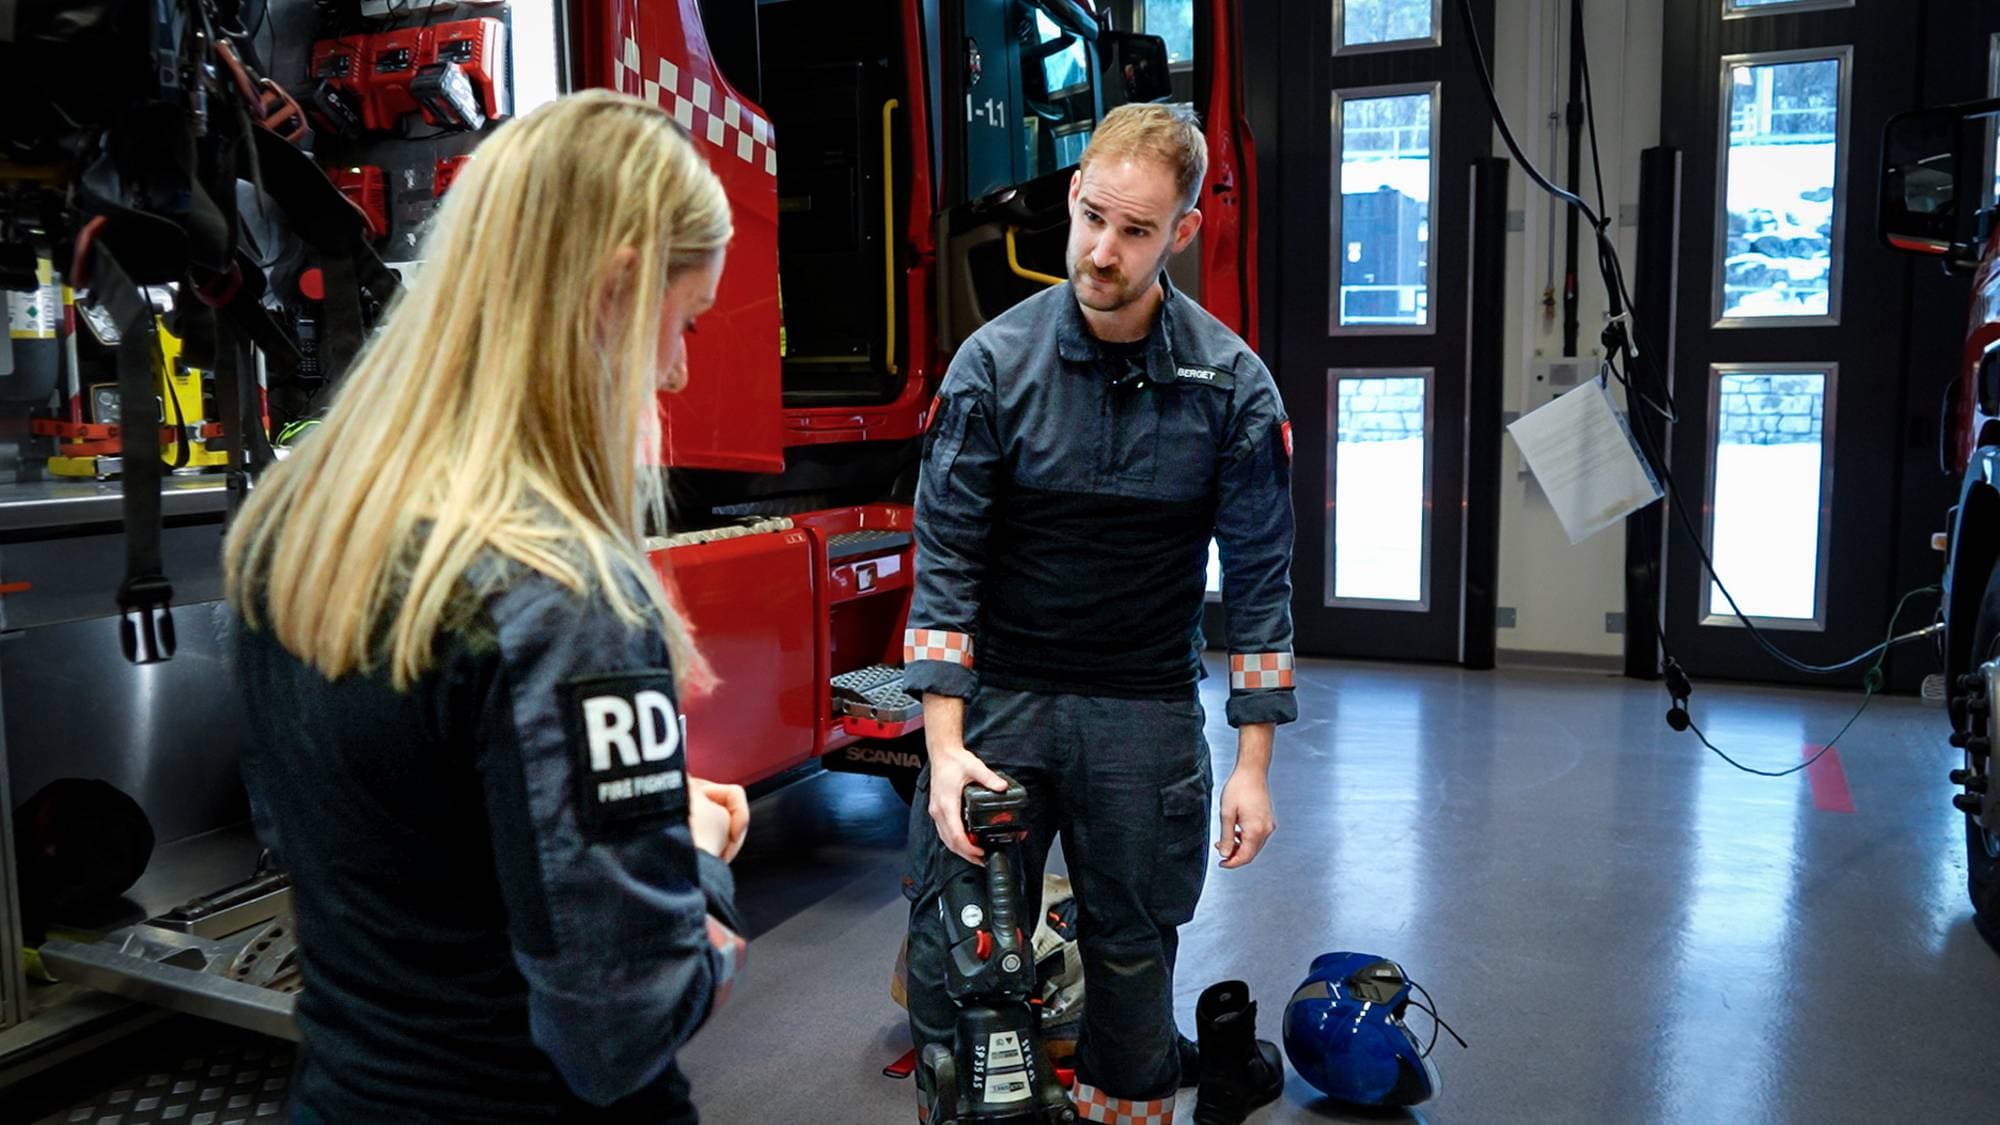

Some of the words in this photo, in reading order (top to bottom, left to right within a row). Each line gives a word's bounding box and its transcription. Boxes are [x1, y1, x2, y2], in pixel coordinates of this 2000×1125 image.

[1177, 367, 1217, 381] BERGET
[582, 690, 680, 772] RD
[846, 747, 922, 769] SCANIA
[598, 778, 633, 804] FIRE
[633, 769, 683, 797] FIGHTER
